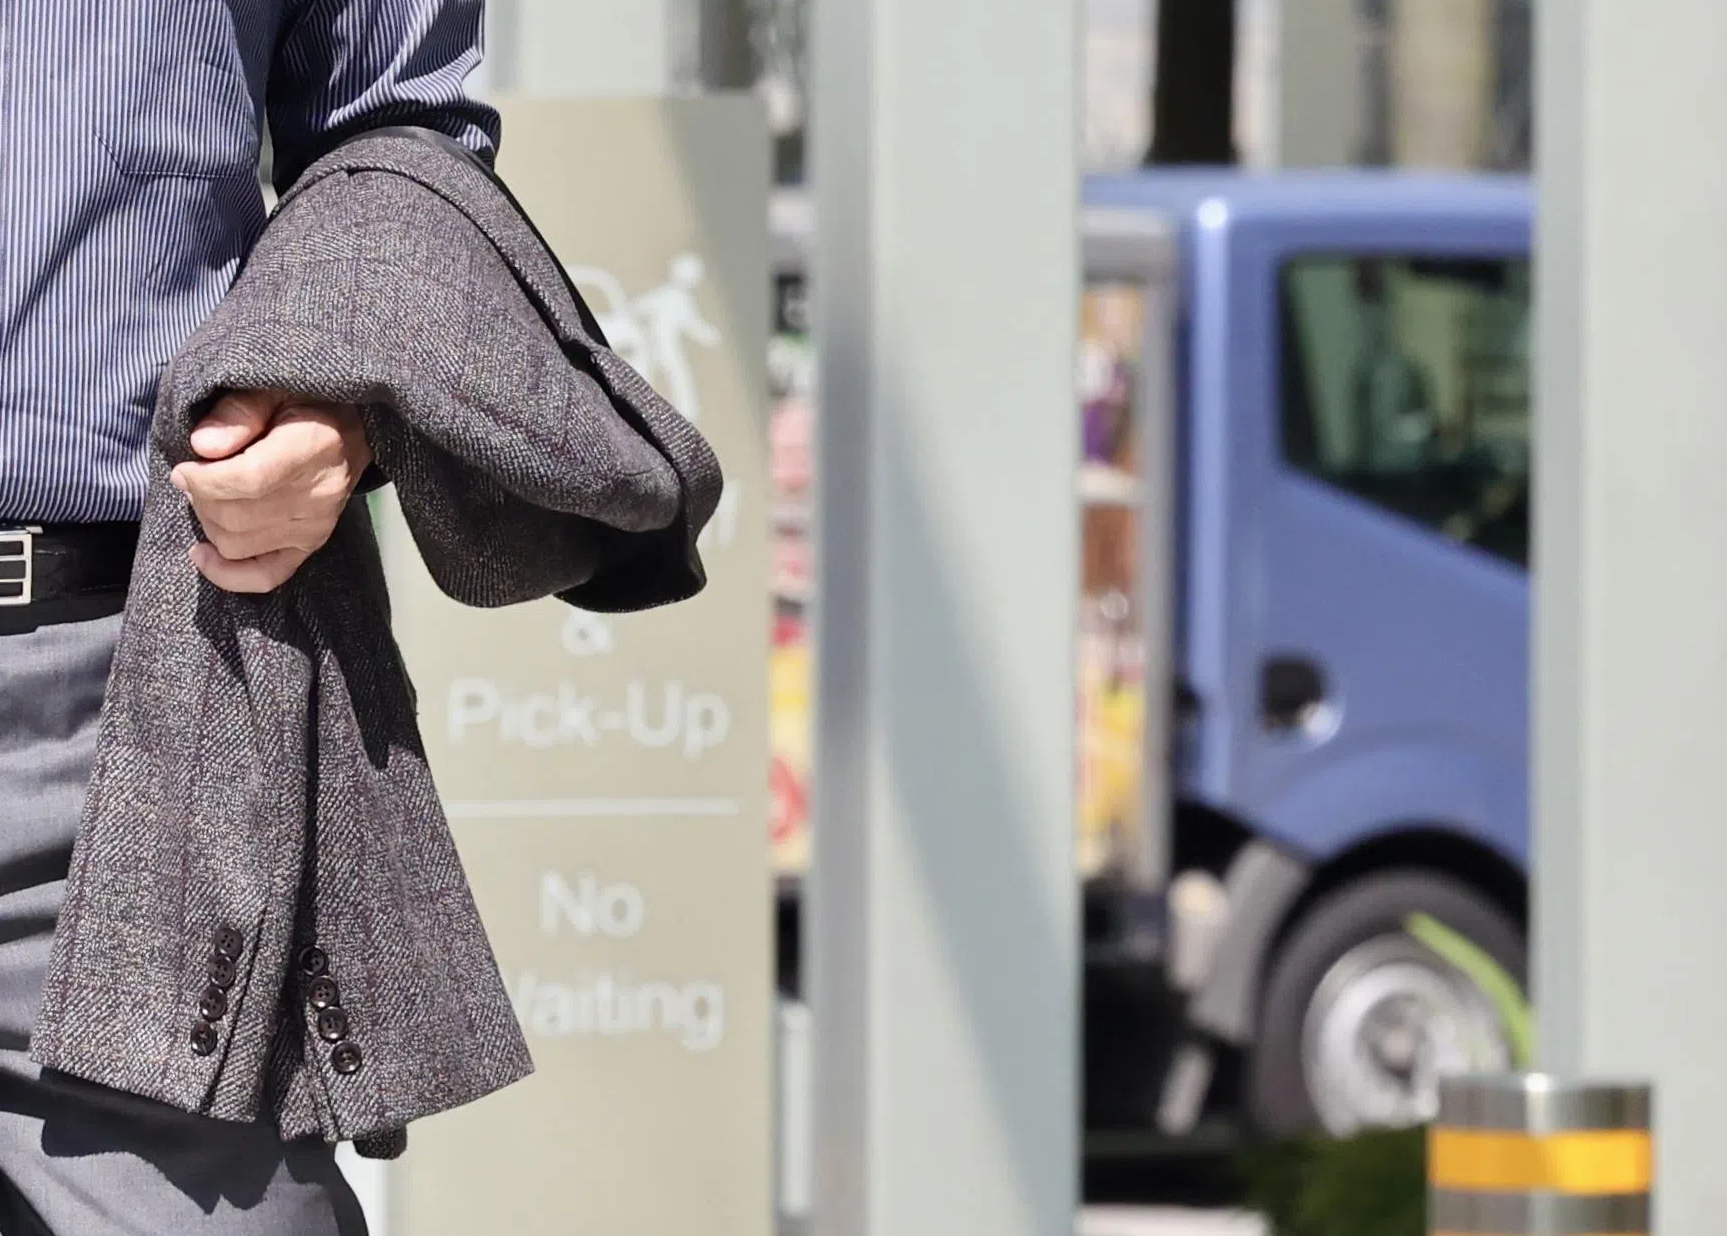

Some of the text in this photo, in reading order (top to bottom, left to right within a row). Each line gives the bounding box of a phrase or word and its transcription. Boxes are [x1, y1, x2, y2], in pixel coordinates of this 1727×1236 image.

[447, 678, 731, 760] Pick-Up
[538, 870, 646, 938] No
[511, 969, 726, 1052] aiting
